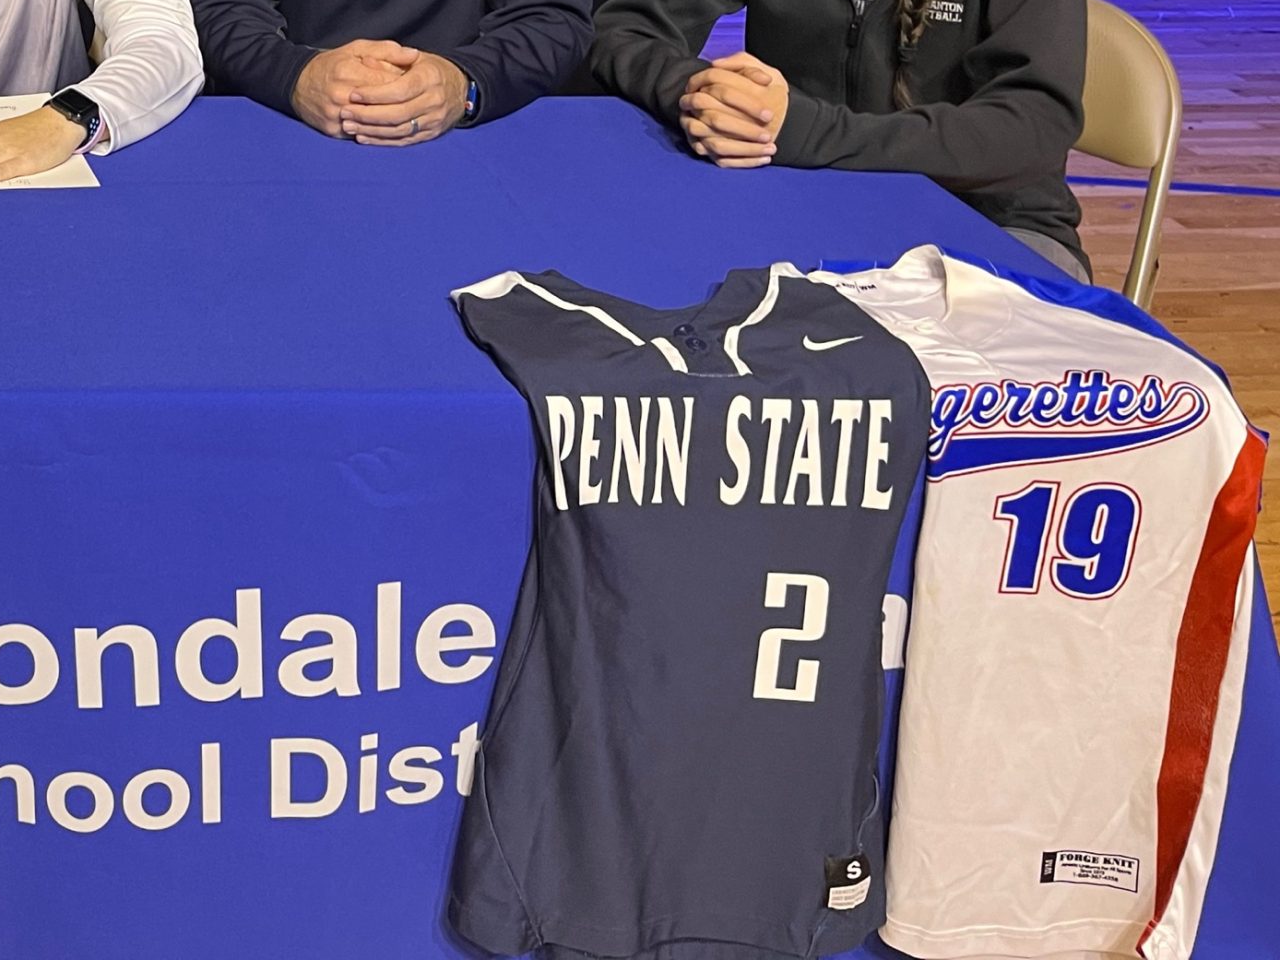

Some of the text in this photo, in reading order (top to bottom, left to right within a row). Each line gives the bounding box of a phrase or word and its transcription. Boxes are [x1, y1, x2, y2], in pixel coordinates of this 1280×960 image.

[545, 394, 894, 511] PENN STATE
[928, 368, 1172, 461] gerettes
[992, 480, 1142, 601] 19
[752, 572, 830, 702] 2
[270, 720, 482, 820] Dist
[847, 860, 862, 879] S
[1059, 853, 1100, 865] FORGE
[1102, 857, 1136, 869] KNIT
